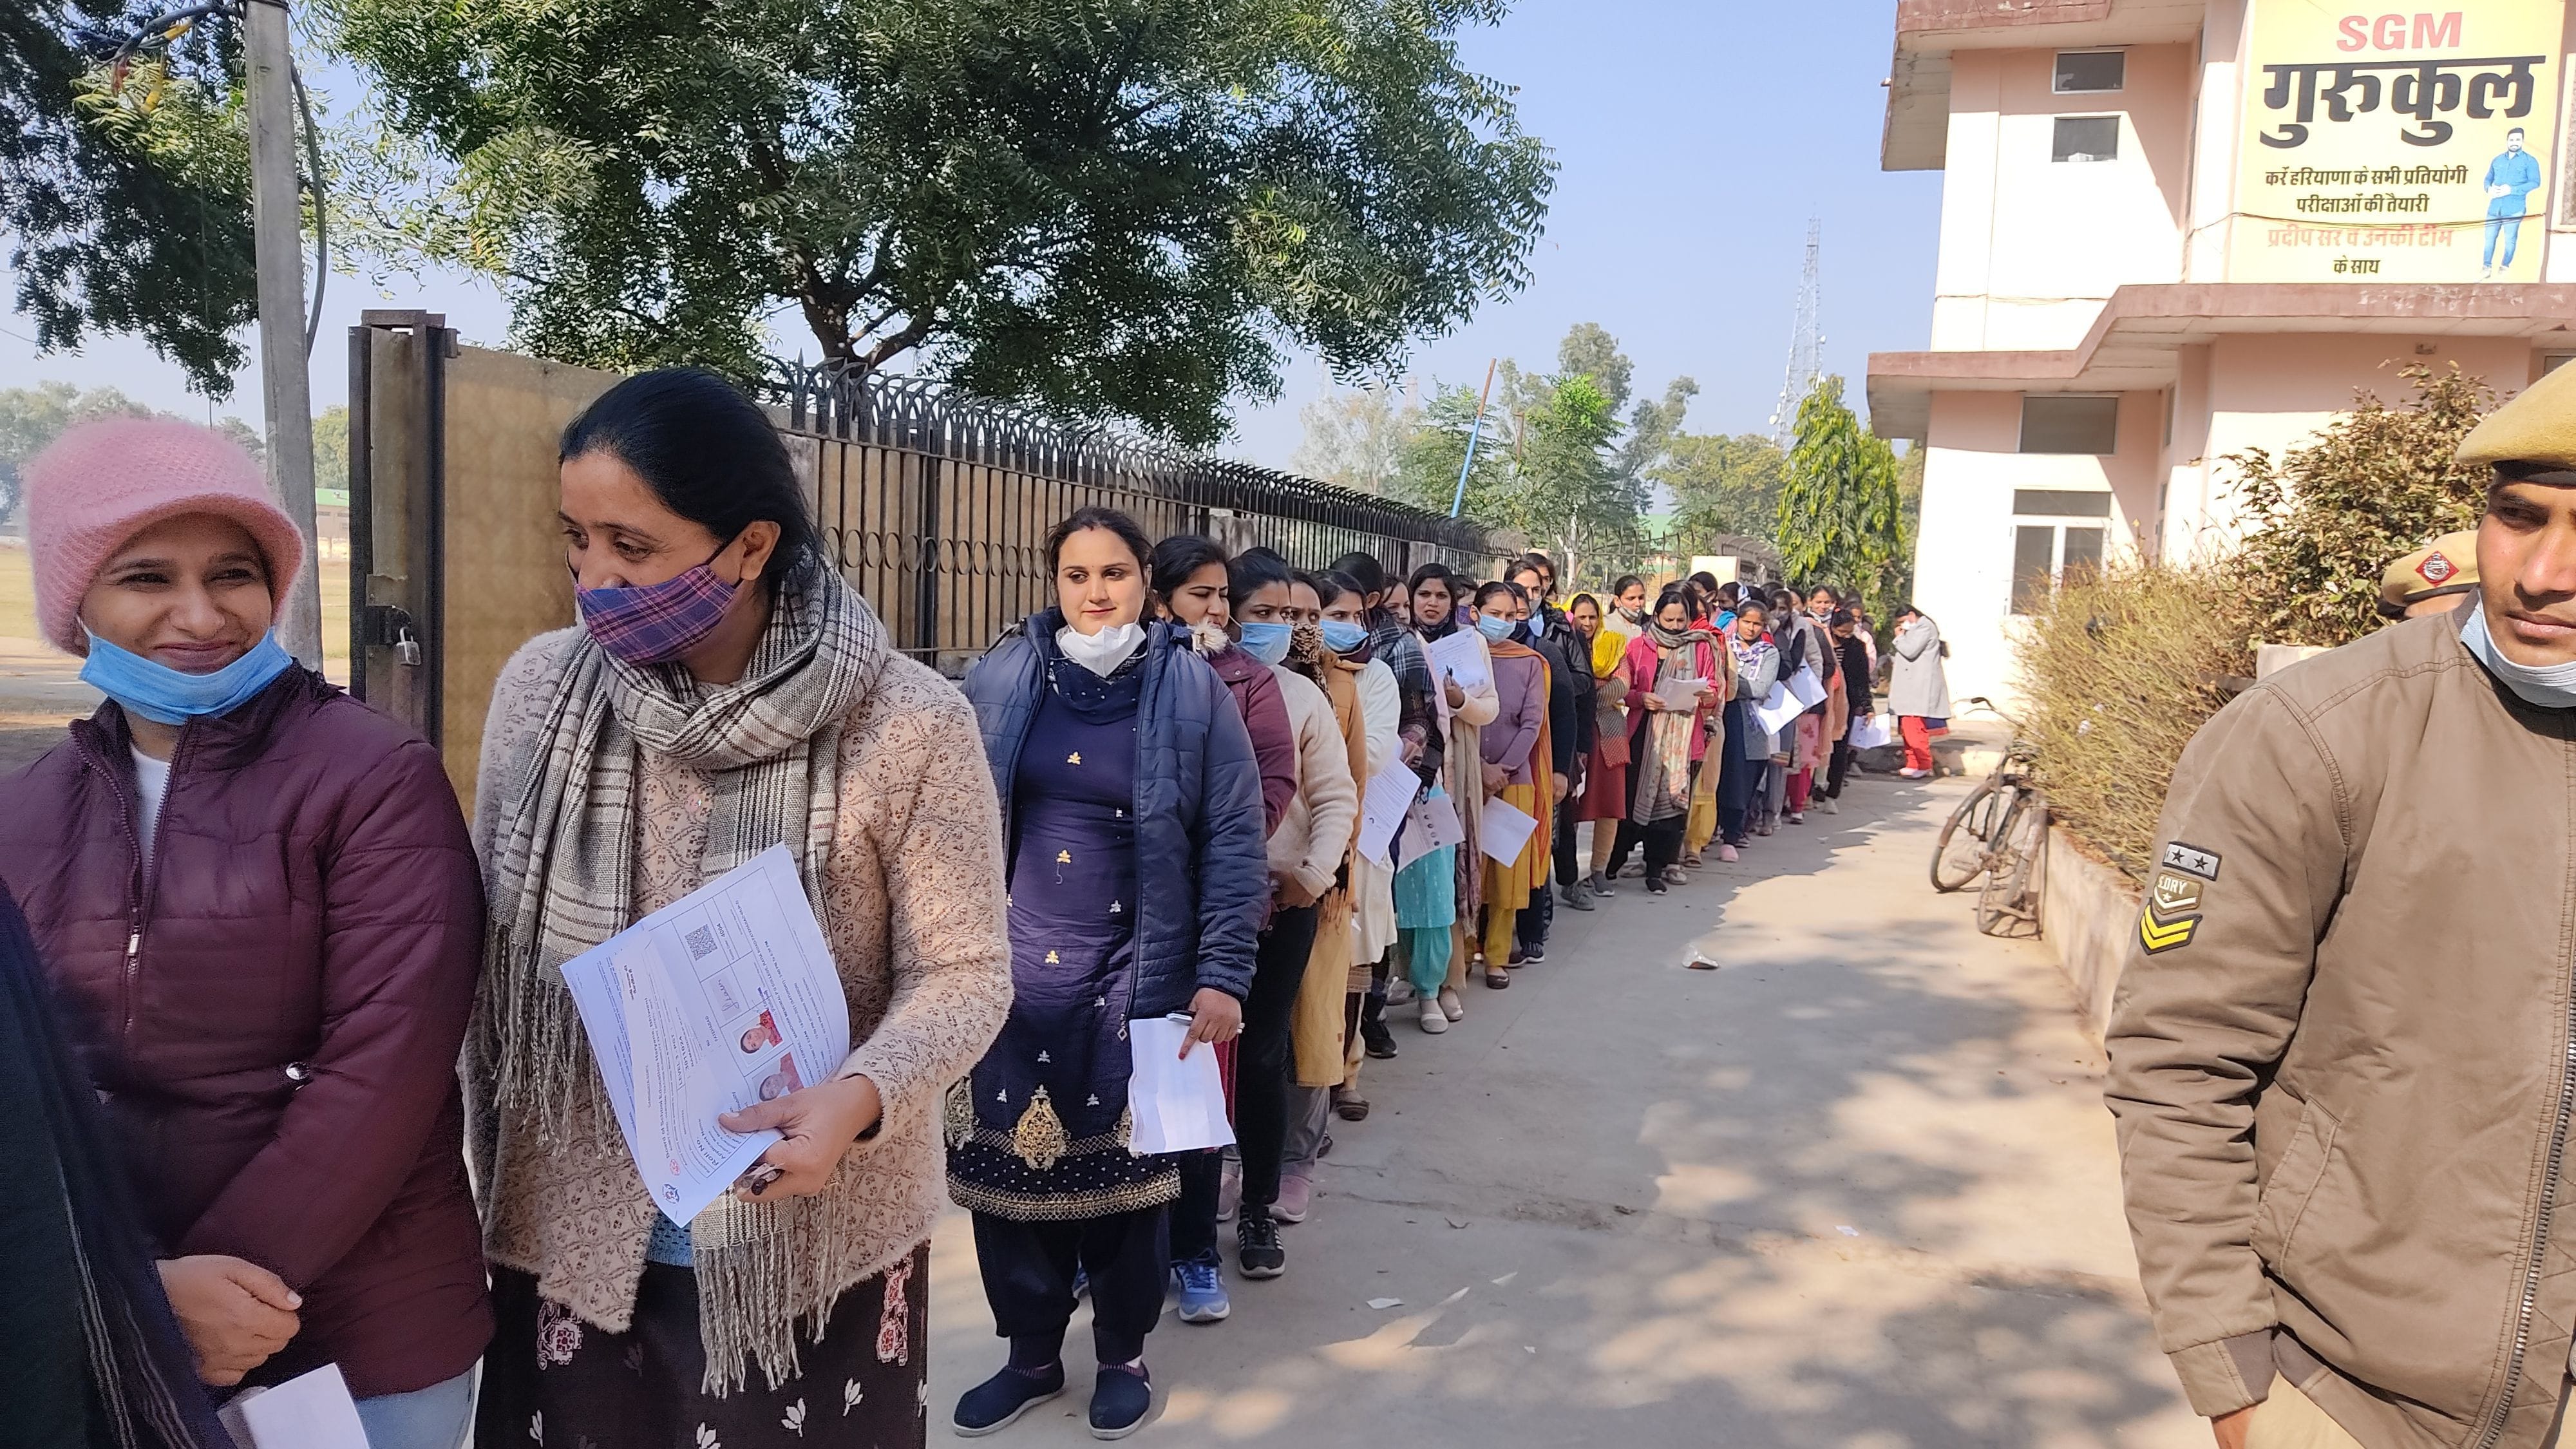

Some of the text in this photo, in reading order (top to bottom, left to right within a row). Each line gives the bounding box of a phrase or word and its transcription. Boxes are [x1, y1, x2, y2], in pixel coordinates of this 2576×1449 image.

[2336, 12, 2463, 52] SGM
[2259, 55, 2546, 149] गुरुकुल
[2266, 165, 2468, 185] करें हरियाणा के सभी प्रतियोगी
[2297, 193, 2430, 213] परीक्षाओं की तैयारी
[2268, 223, 2453, 247] प्रदीप सर व उनकी टीम
[2334, 255, 2349, 274] के
[715, 922, 726, 938] 4004
[703, 1151, 718, 1166] Roll
